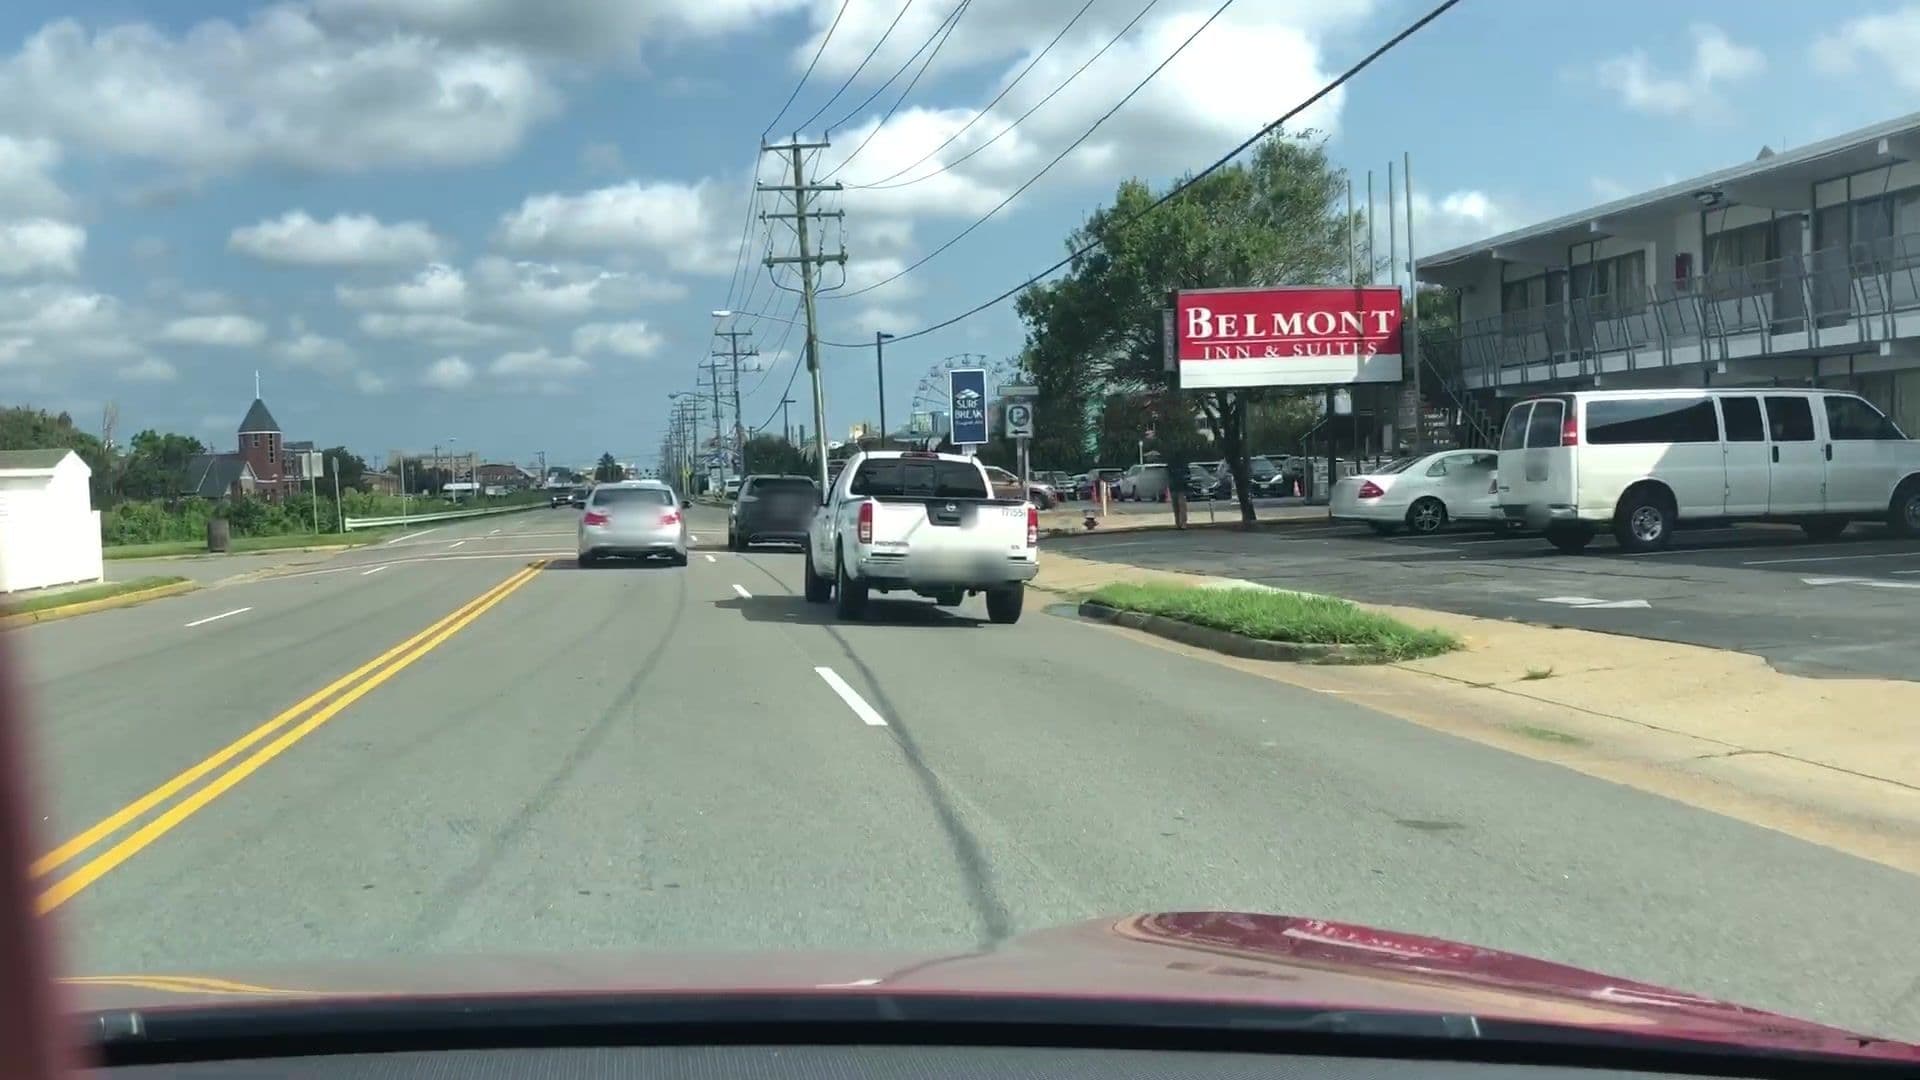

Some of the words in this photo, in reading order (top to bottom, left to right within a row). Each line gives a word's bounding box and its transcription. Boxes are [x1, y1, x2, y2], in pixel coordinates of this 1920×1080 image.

[1185, 307, 1395, 338] BELMONT
[1204, 345, 1251, 360] INN
[1263, 345, 1279, 358] &
[1293, 341, 1378, 357] SUITES
[955, 399, 978, 409] SURF
